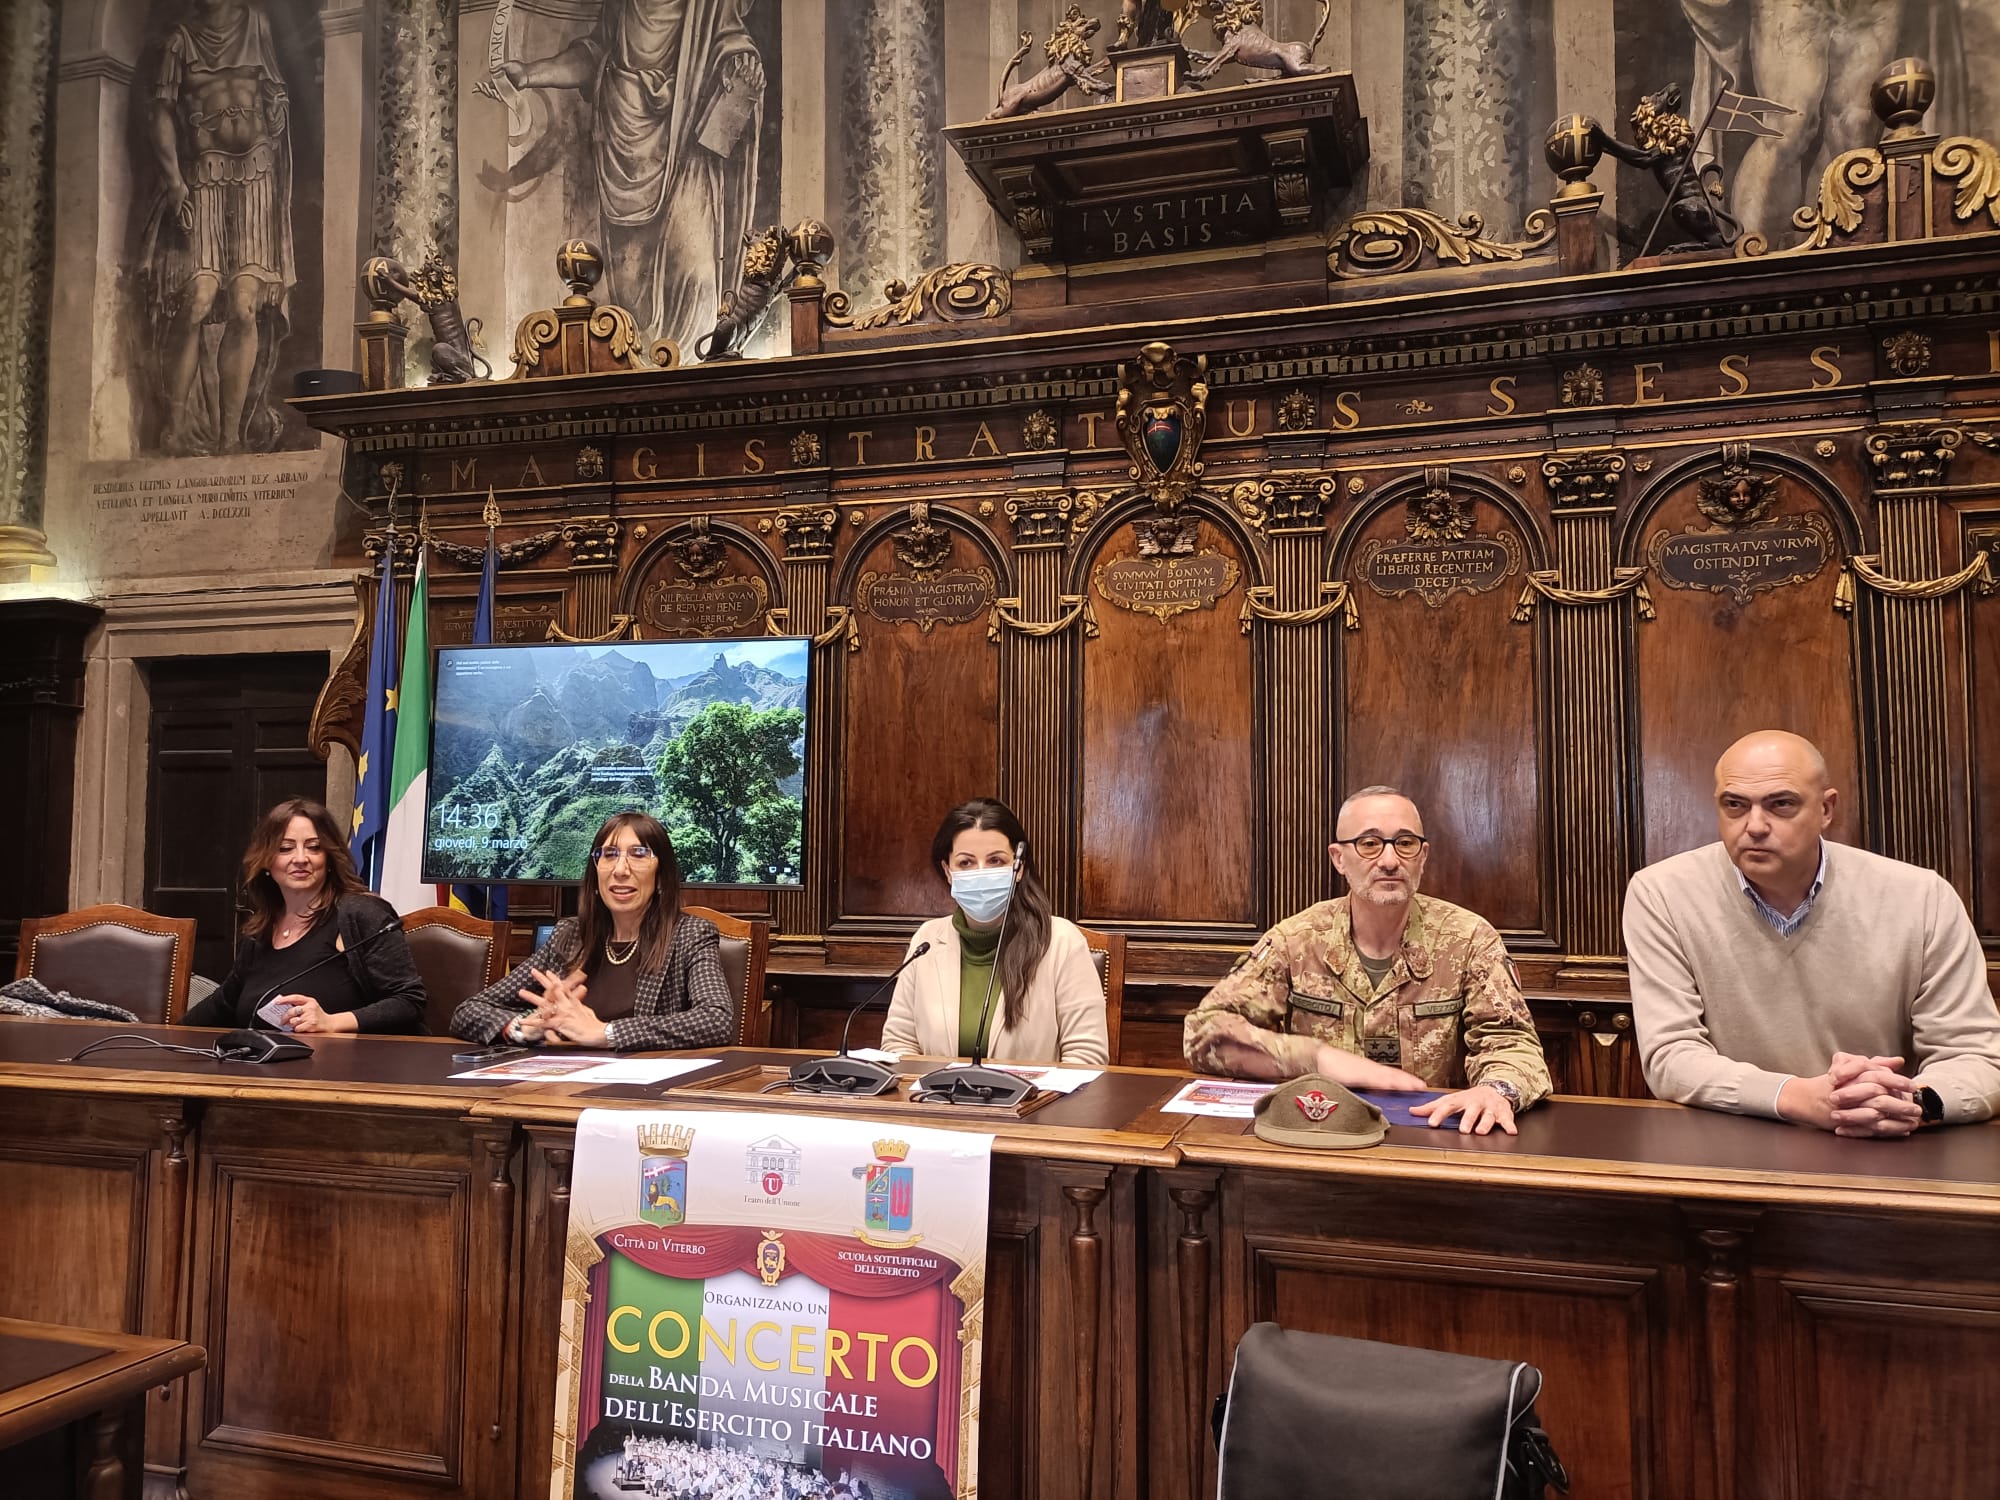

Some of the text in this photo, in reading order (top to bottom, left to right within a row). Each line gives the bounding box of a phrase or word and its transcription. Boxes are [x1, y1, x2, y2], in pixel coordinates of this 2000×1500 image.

[1082, 192, 1255, 232] IVSTITIA
[1114, 223, 1212, 253] BASIS
[252, 474, 269, 484] REX
[143, 497, 153, 507] ET
[254, 489, 294, 500] VITERBIUM
[1666, 536, 1818, 556] MAGISTRATVS VIRVM
[1442, 550, 1494, 561] PATRIAM
[1693, 554, 1773, 570] OSTENDIT
[1113, 567, 1213, 581] SVMMVM BONVM
[1376, 562, 1493, 576] LIBERIS REGENTEM
[920, 582, 985, 595] MAGISTRATVS
[1116, 577, 1216, 591] CIVITATI OPTIME
[1415, 576, 1459, 588] DECET
[874, 594, 975, 607] HONOR ET GLORIA
[1133, 589, 1200, 600] GVBERNARI
[660, 604, 673, 613] DE
[716, 602, 742, 612] BENE
[437, 803, 498, 829] 14:36
[481, 836, 489, 849] 9
[492, 838, 528, 850] marzo
[662, 1237, 706, 1255] VITERBO
[838, 1251, 937, 1269] SCUOLA SOTTUFFICIALI
[854, 1264, 920, 1278] DELL'ESERCITO
[704, 1291, 827, 1315] ORGANIZZANO UN
[606, 1305, 938, 1388] CONCERTO
[609, 1366, 878, 1418] DELLA BANDA MUSICALE
[604, 1396, 931, 1460] DELL'ESERCITO ITALIANO
